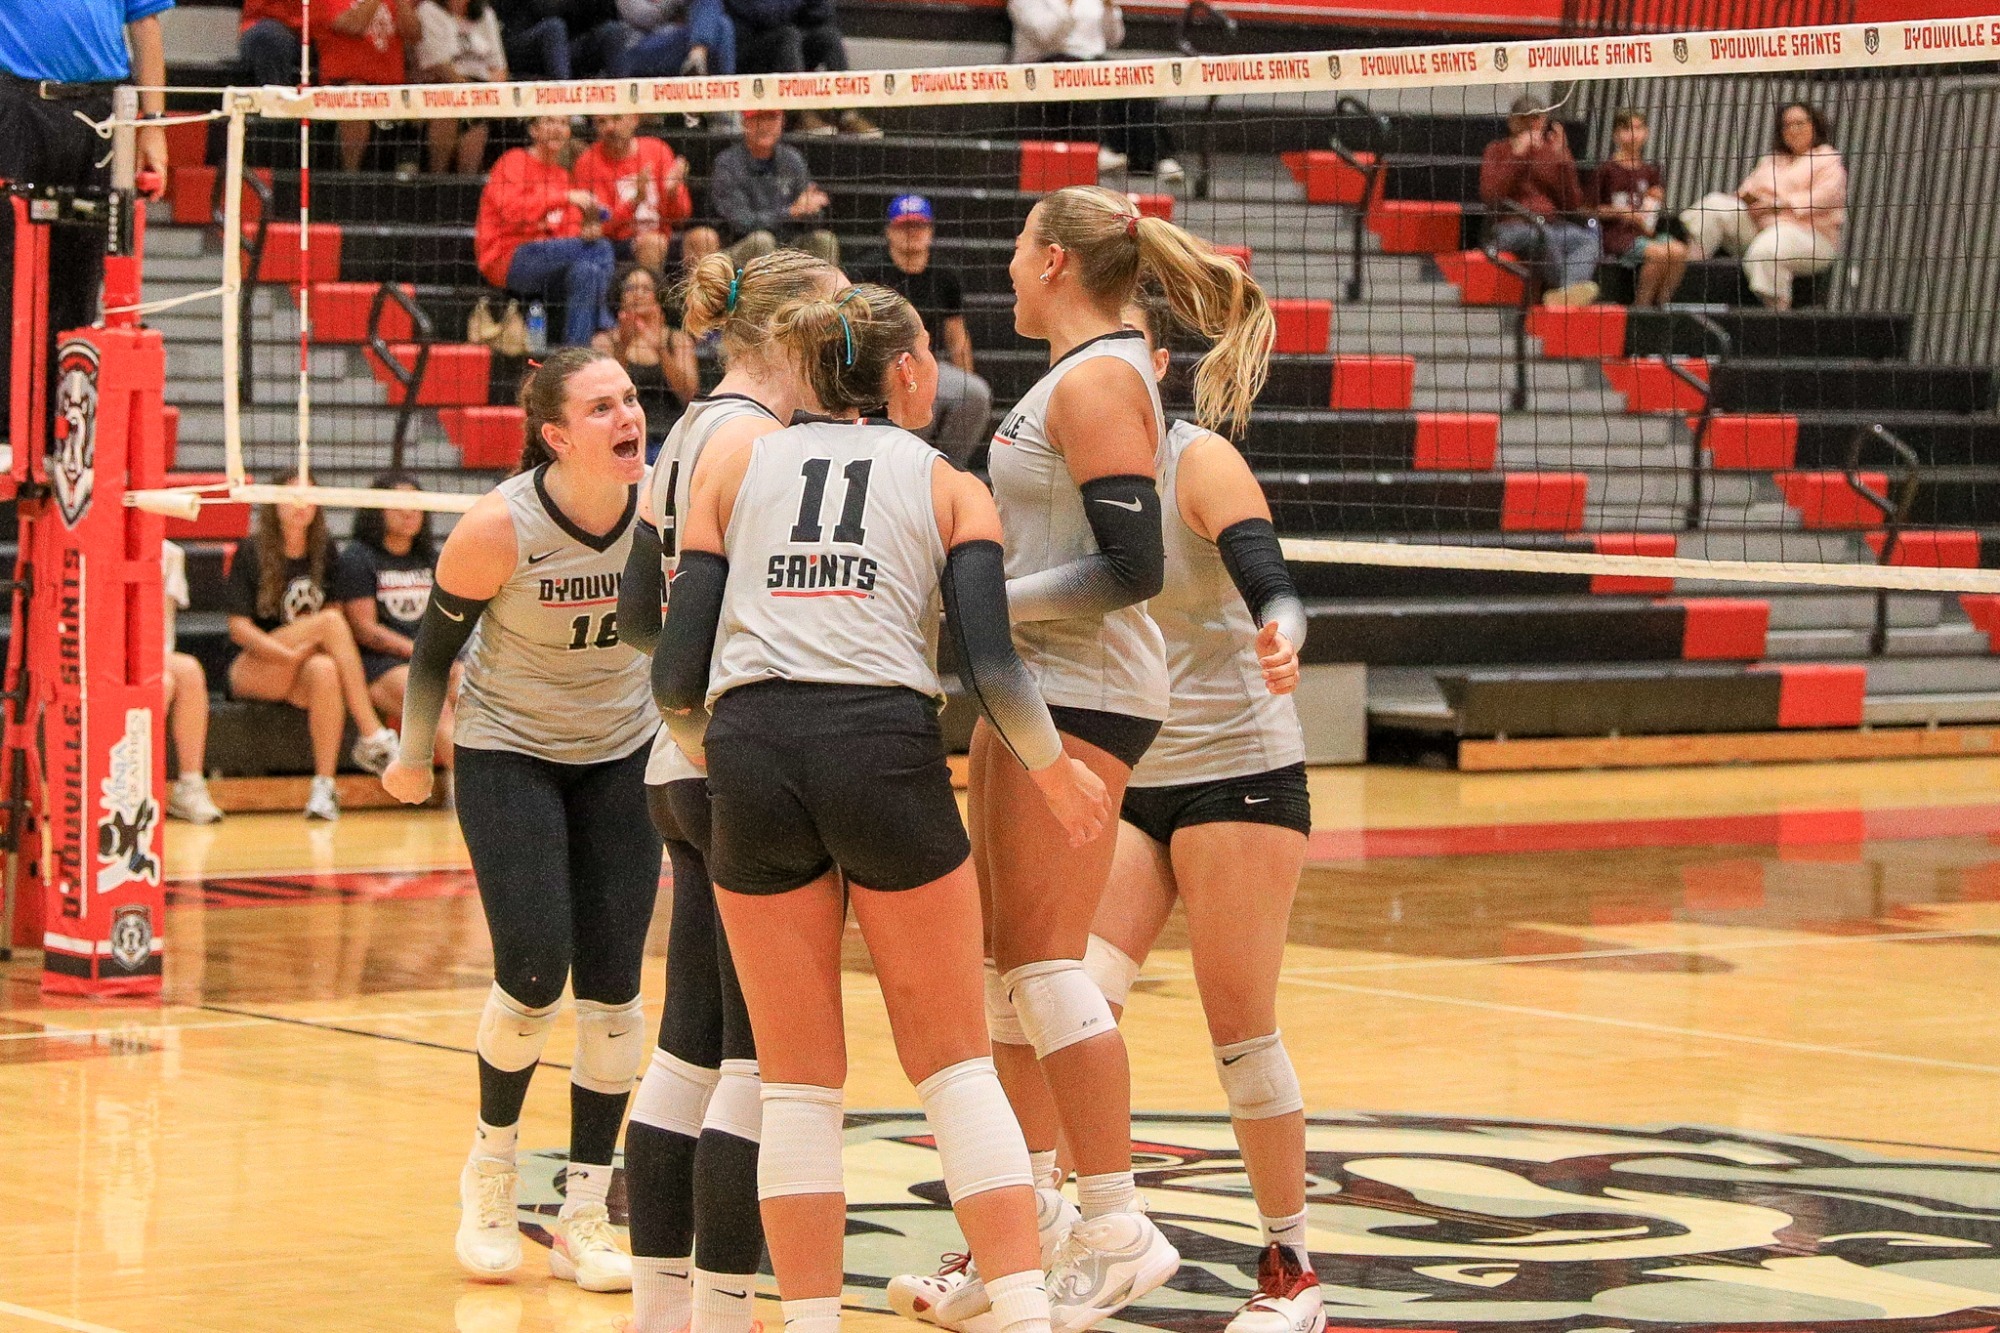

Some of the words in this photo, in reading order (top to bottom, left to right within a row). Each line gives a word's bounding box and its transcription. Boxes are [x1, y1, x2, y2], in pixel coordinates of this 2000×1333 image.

[1710, 35, 1787, 60] D'YOUVILLE
[1904, 24, 1985, 50] D'YOUVILLE
[1360, 54, 1427, 76] D'YOUVILLE
[1528, 45, 1599, 68] D'YOUVILLE
[788, 457, 876, 547] 11
